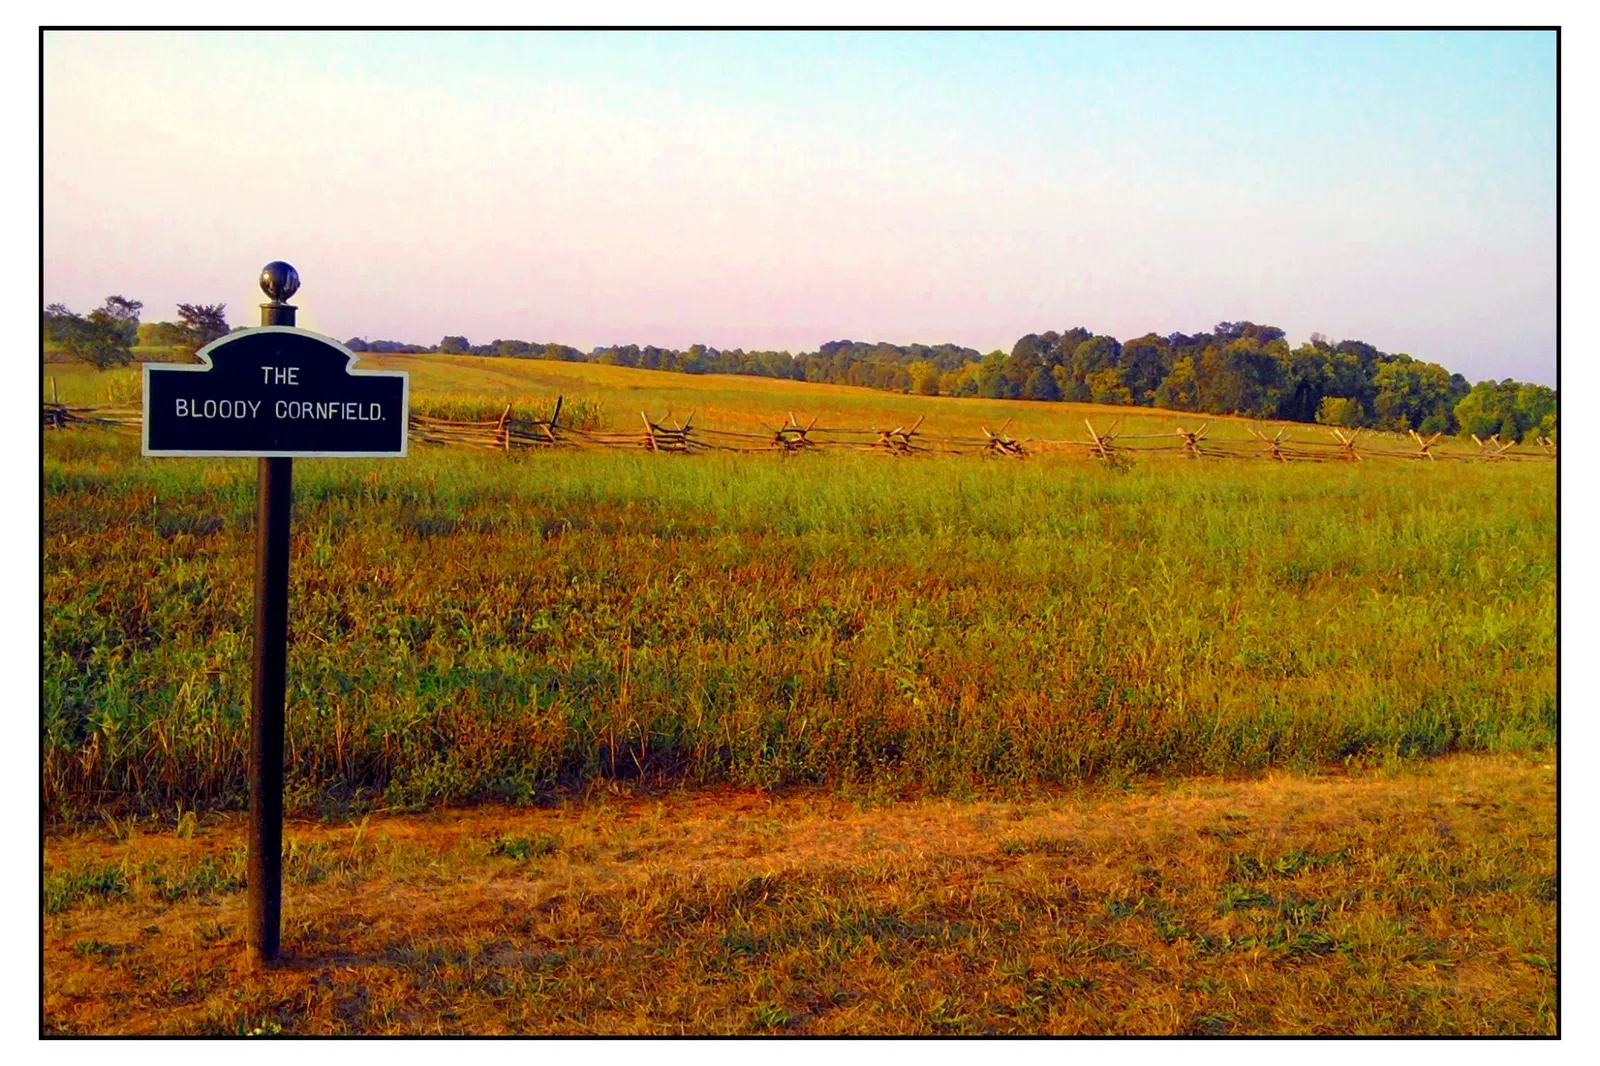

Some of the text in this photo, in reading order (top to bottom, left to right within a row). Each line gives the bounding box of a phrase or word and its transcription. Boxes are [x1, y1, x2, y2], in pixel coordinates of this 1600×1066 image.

[261, 366, 299, 386] THE
[175, 398, 387, 421] BLOODY CORNFIELD.
